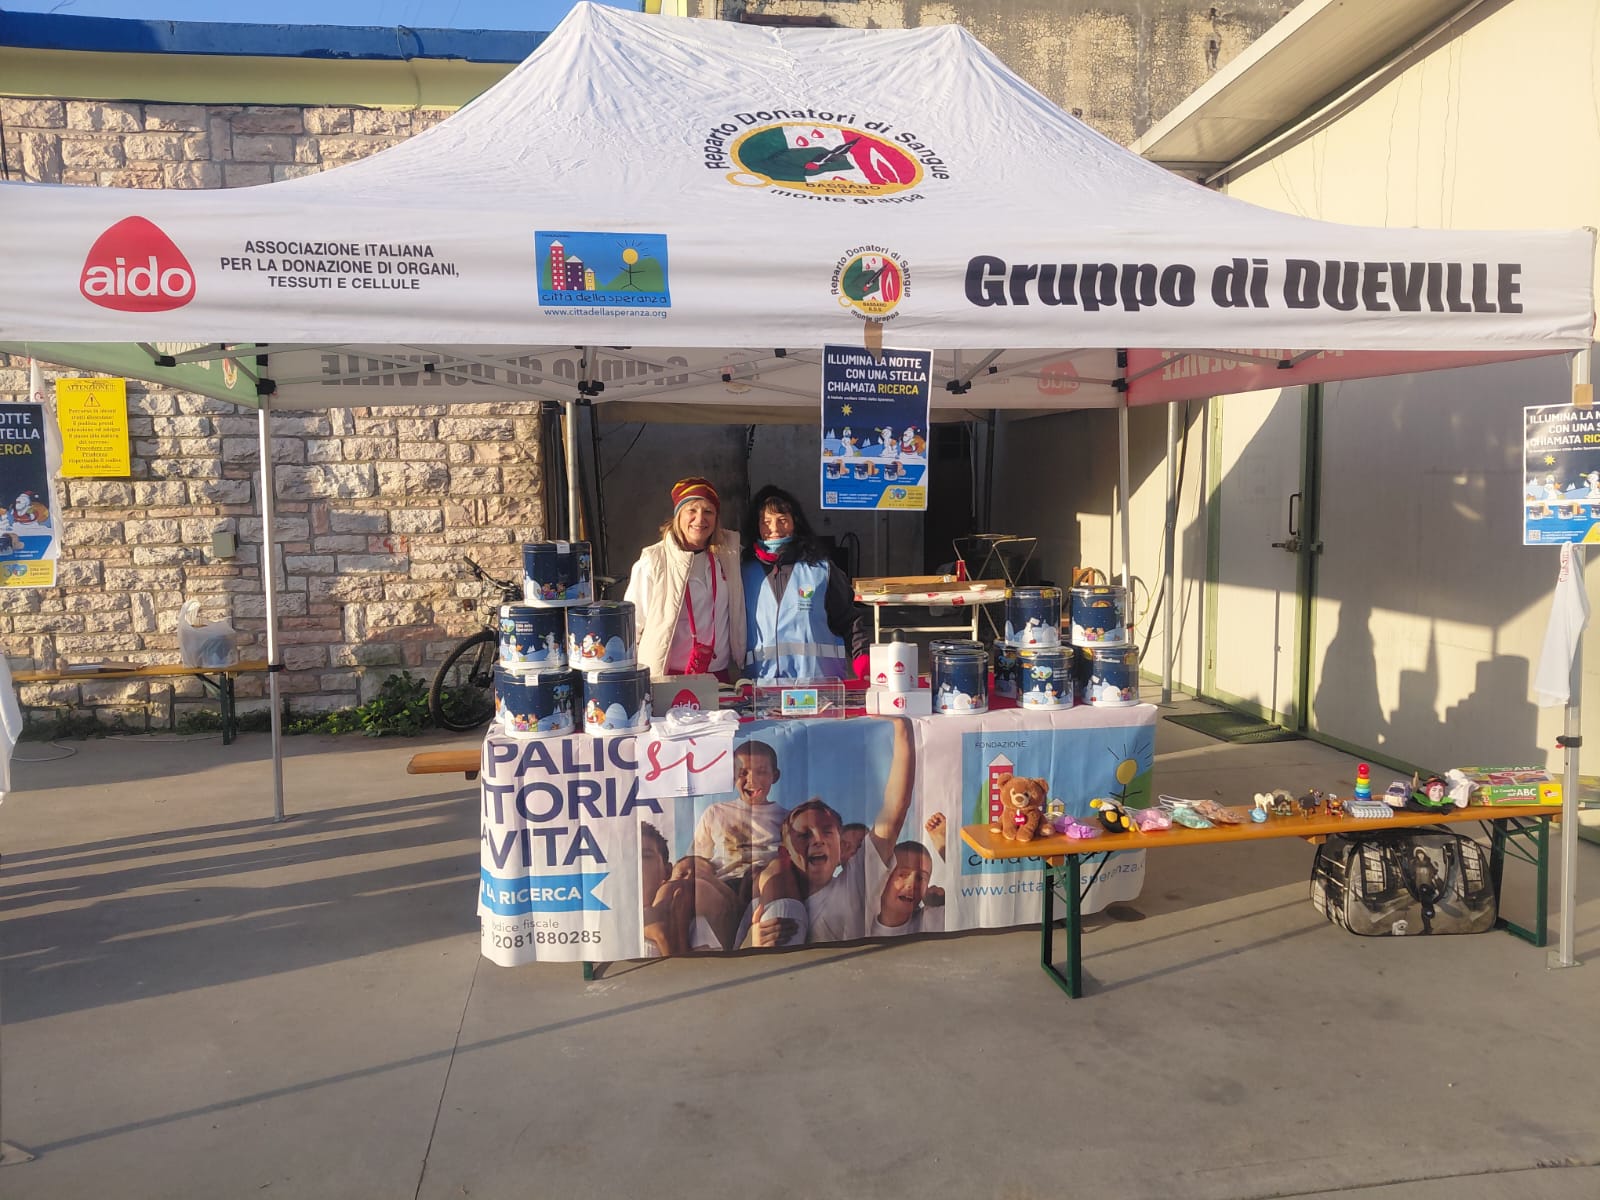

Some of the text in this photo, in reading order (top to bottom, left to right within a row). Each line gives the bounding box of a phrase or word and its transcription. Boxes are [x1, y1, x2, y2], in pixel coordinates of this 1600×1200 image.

[704, 108, 950, 180] Reparto Donatori di Sangue
[771, 189, 925, 205] monte grappa
[244, 240, 435, 258] ASSOCIAZIONE ITALIANA
[220, 257, 460, 278] PER LA DONAZIONE DI ORGANI,
[830, 244, 911, 298] Reparto Donatori di Sangue
[84, 256, 193, 298] aido
[268, 275, 421, 290] TESSUTI E CELLULE
[964, 254, 1524, 314] Gruppo di DUEVILLE
[544, 308, 667, 319] www.cittadellasperanza.org
[850, 309, 900, 324] monte grappa
[827, 353, 922, 369] ILLUMINA LA NOTTE
[846, 369, 927, 382] CON UNA STELLA
[827, 381, 919, 395] CHIAMATA RICERCA
[1530, 412, 1578, 424] ILLUMINA
[1580, 411, 1594, 421] LA
[1549, 424, 1570, 434] CON
[1572, 423, 1595, 433] UNA
[1531, 435, 1581, 446] CHIAMATA
[974, 740, 1028, 749] FONDAZIONE
[1516, 788, 1537, 797] ABC
[488, 825, 608, 870] VITA
[499, 886, 582, 905] RICERCA
[523, 918, 560, 930] fiscale
